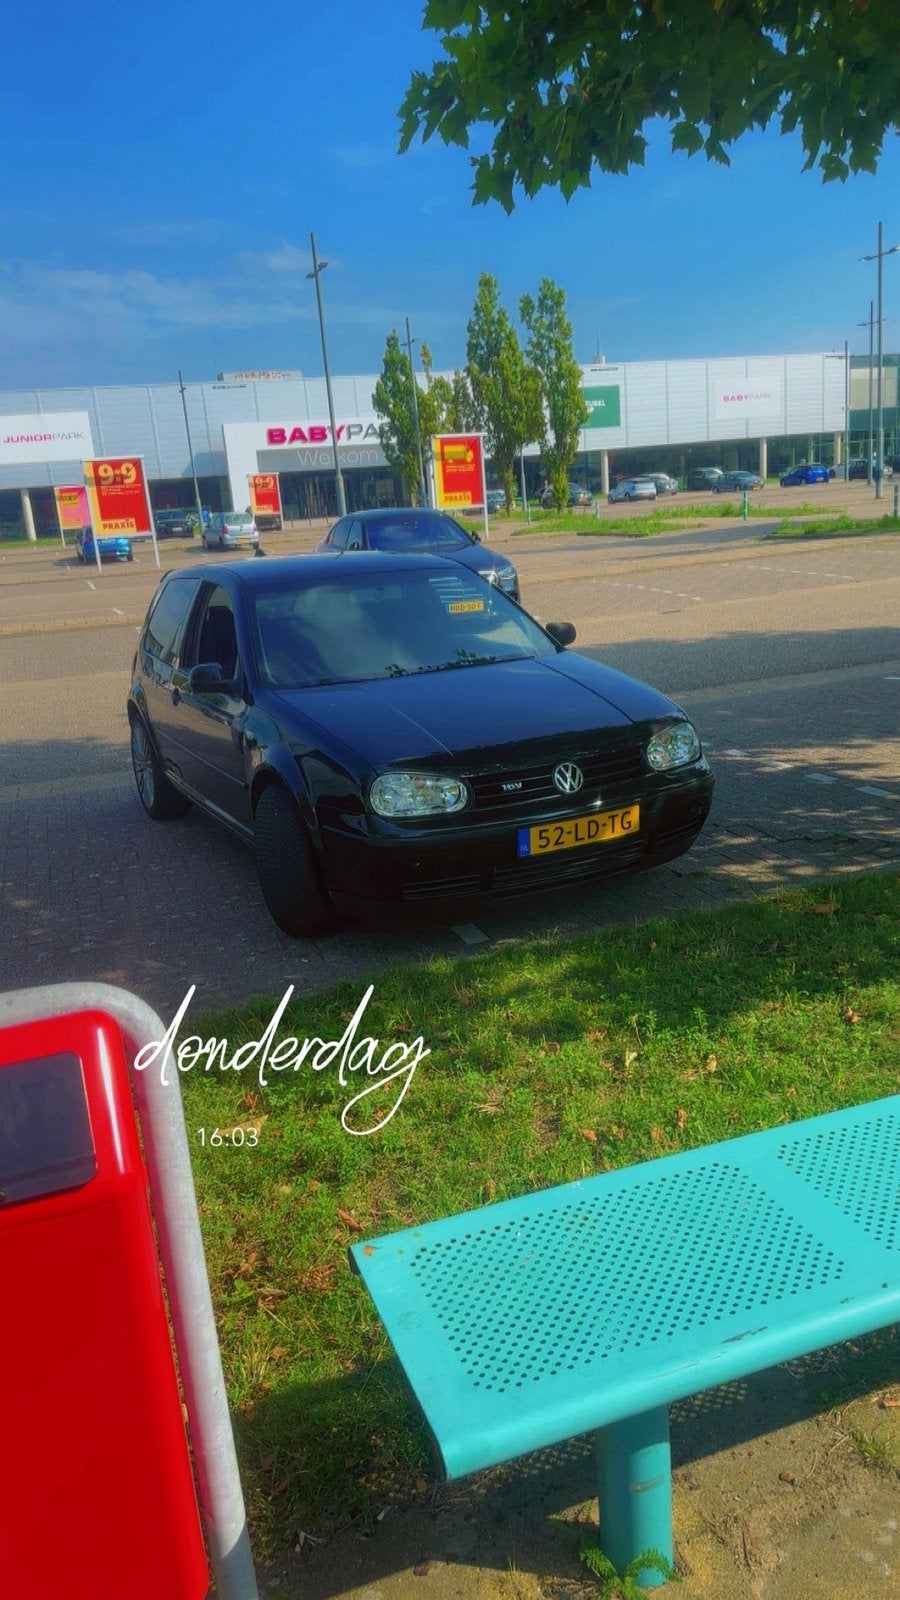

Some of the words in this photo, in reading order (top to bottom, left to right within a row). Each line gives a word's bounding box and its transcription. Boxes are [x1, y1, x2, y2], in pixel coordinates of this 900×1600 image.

[3, 432, 85, 443] JUNIORPARK
[267, 423, 381, 445] BABYPA
[296, 449, 379, 467] Welkom
[444, 493, 471, 503] PRAXIS
[103, 520, 135, 531] PRAXIS
[500, 781, 523, 792] 16V
[537, 811, 632, 849] 52-LD-TG
